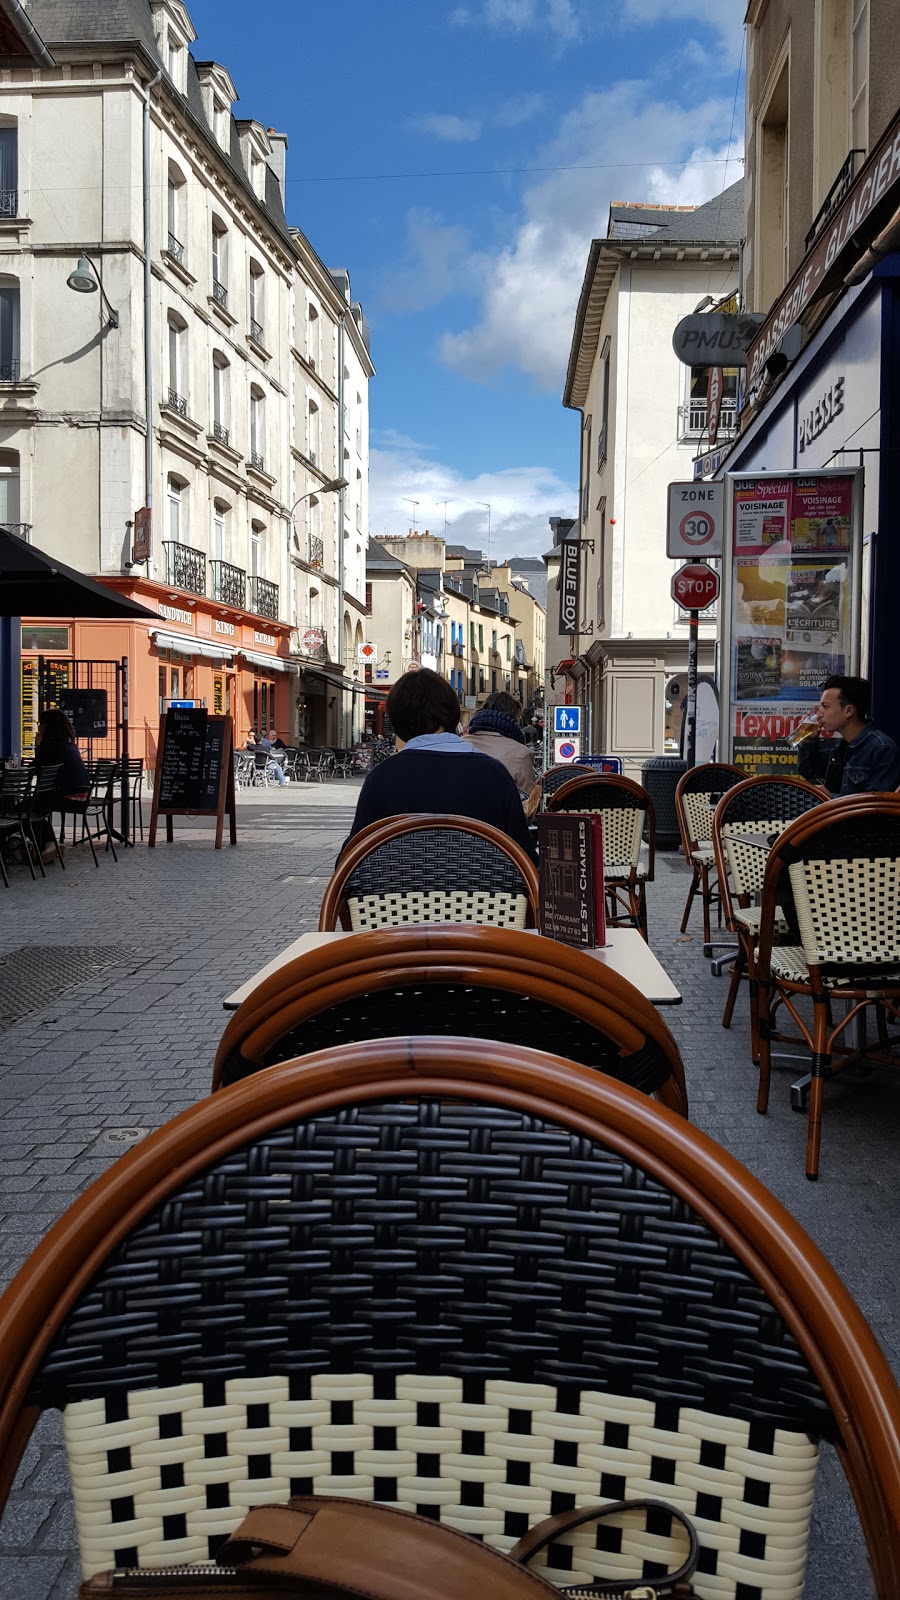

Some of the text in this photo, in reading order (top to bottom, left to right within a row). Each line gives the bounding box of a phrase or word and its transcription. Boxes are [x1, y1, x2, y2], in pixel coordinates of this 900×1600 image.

[750, 264, 813, 380] BRASSERIE
[681, 330, 736, 349] PMU
[708, 367, 719, 436] ABAC
[799, 377, 845, 453] PRESSE
[735, 481, 789, 498] QUE Spécial
[797, 478, 817, 487] QUE
[681, 490, 714, 501] ZONE
[802, 496, 842, 505] VOISINAGE
[740, 501, 784, 511] VOISINAGE
[686, 520, 708, 537] 30
[567, 545, 577, 591] BLUE
[677, 581, 714, 594] STOP
[158, 604, 192, 626] SANDWICH
[565, 597, 576, 631] BOX
[788, 617, 837, 627] L'ÉCRITURE
[214, 620, 235, 636] KING
[254, 631, 275, 646] KEBAB
[735, 753, 798, 765] ARRÊTON
[744, 764, 756, 772] LE
[579, 821, 588, 890] CHARLES
[544, 911, 580, 924] RESTAURANT
[580, 900, 587, 920] ST
[581, 923, 588, 943] LE
